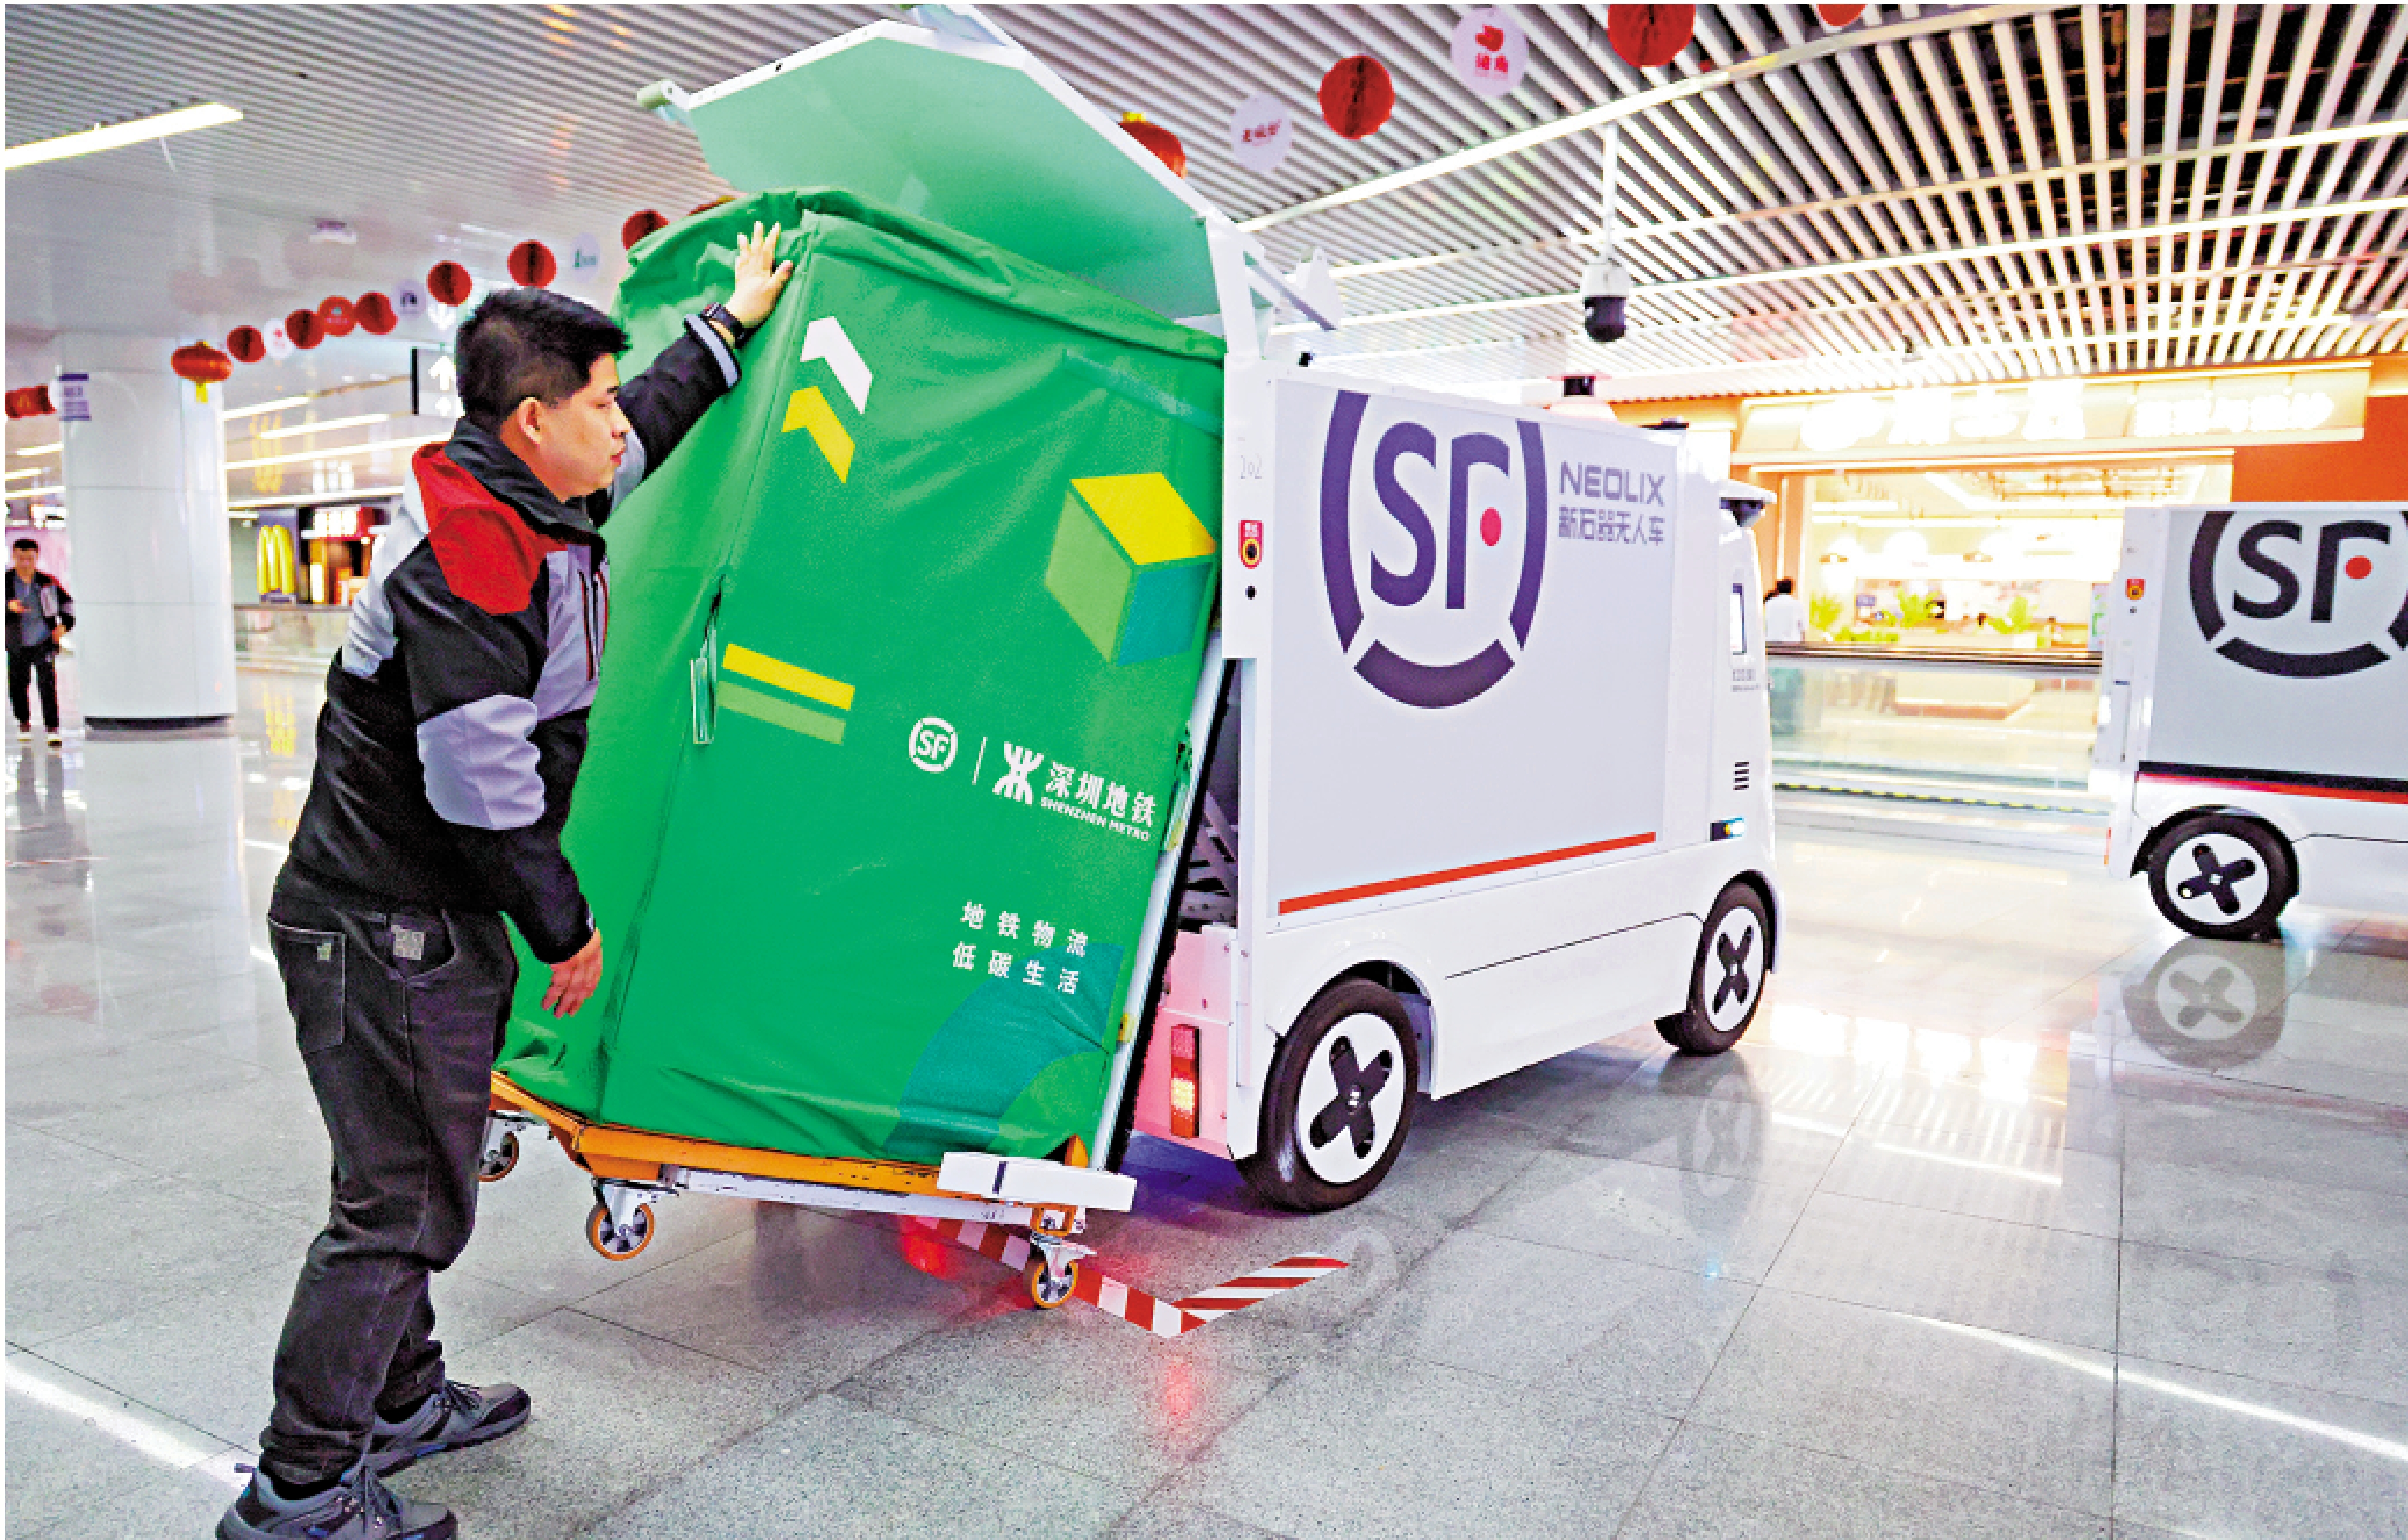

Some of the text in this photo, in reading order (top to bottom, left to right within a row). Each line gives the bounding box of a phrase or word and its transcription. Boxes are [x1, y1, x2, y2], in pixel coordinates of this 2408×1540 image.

[1560, 461, 1666, 507] NEOLIX
[1371, 421, 1510, 609] SF
[2233, 520, 2391, 623] SF
[1041, 796, 1150, 842] SHENZHEN METRO
[1045, 762, 1156, 828] 深圳地铁
[959, 900, 1090, 957] 地铁物流
[952, 940, 1080, 995] 低碳生活
